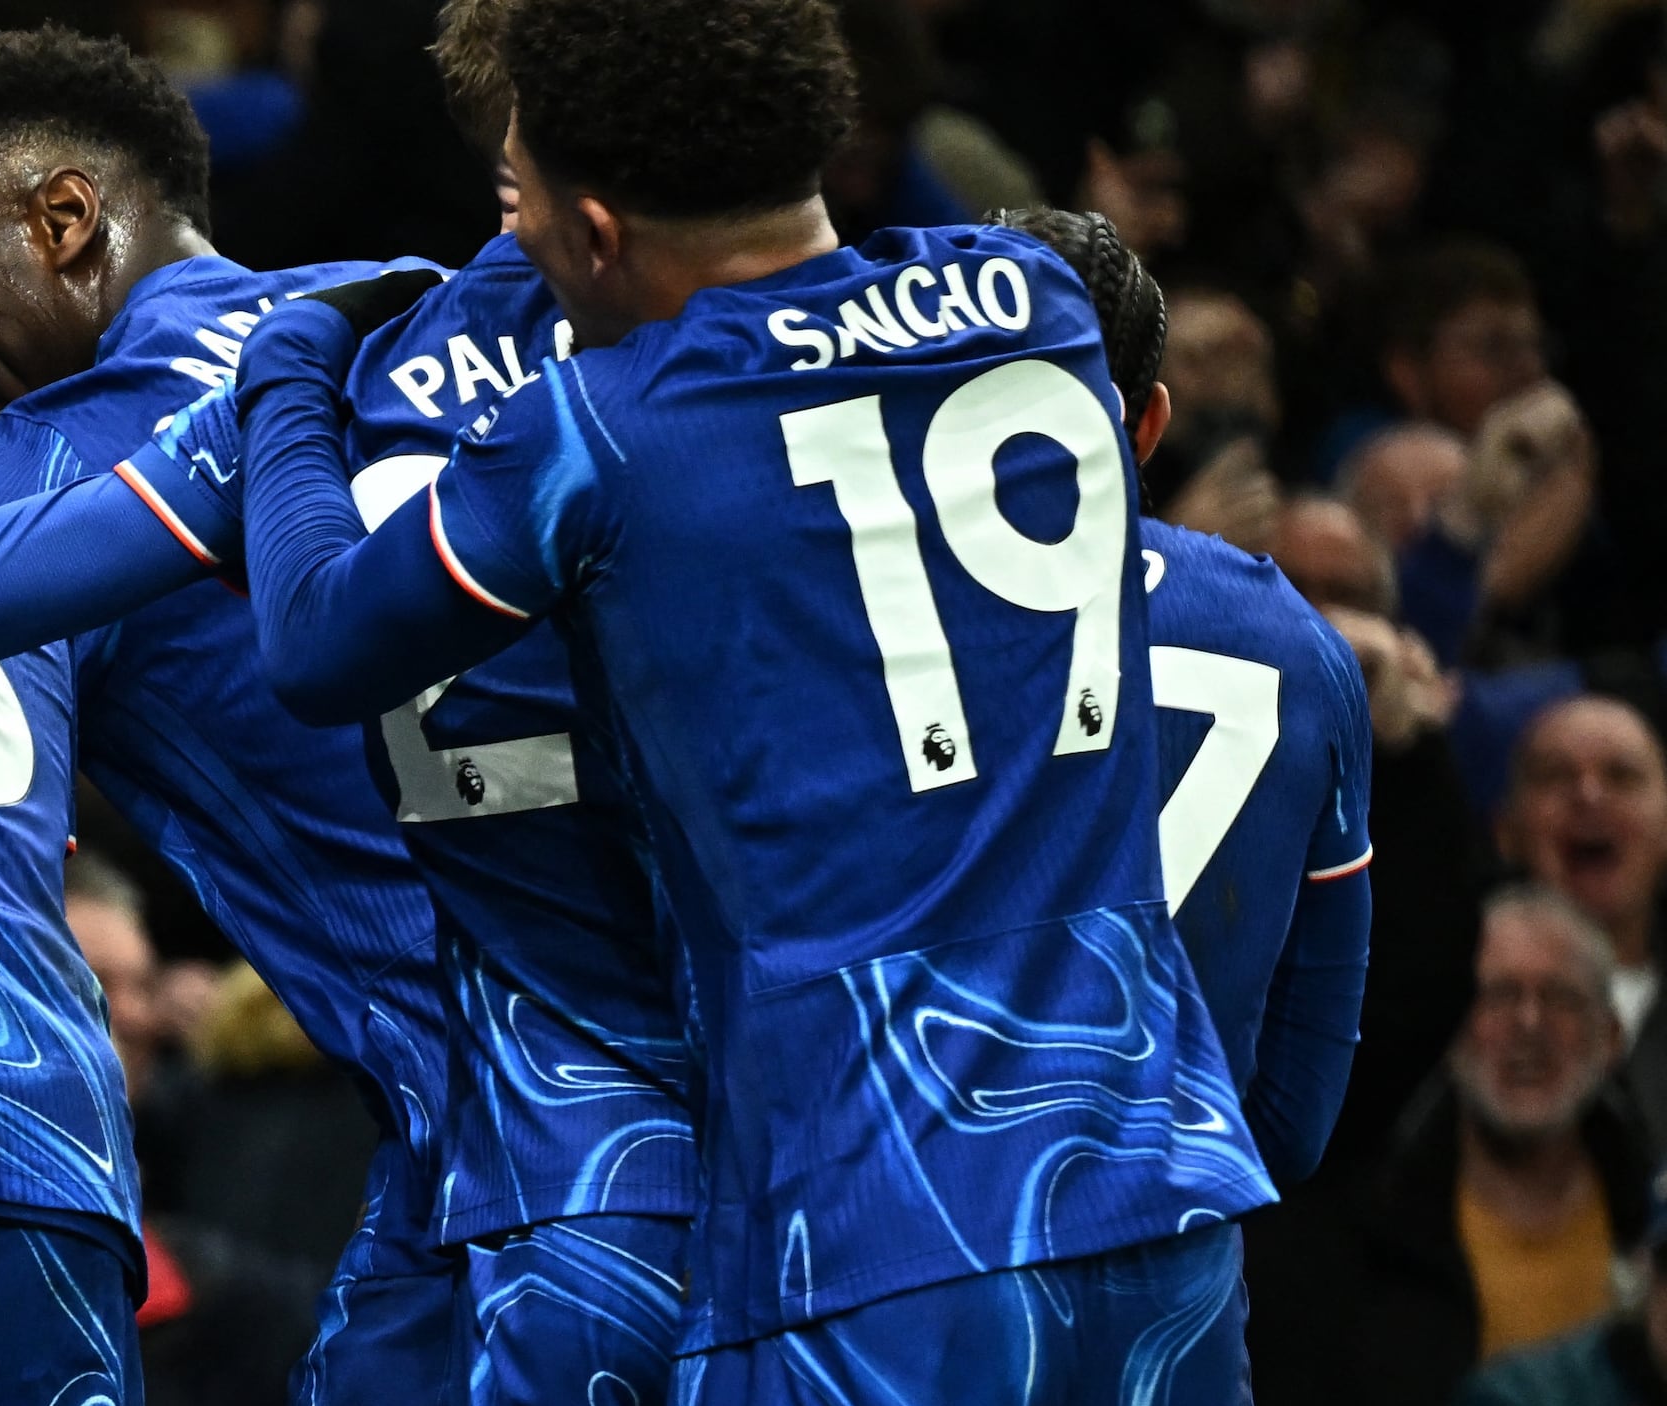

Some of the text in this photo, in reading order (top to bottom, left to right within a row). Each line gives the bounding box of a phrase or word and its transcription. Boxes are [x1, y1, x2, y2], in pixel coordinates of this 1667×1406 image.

[388, 318, 573, 418] PAL
[767, 258, 1030, 372] SANCHO
[780, 359, 1126, 793] 19
